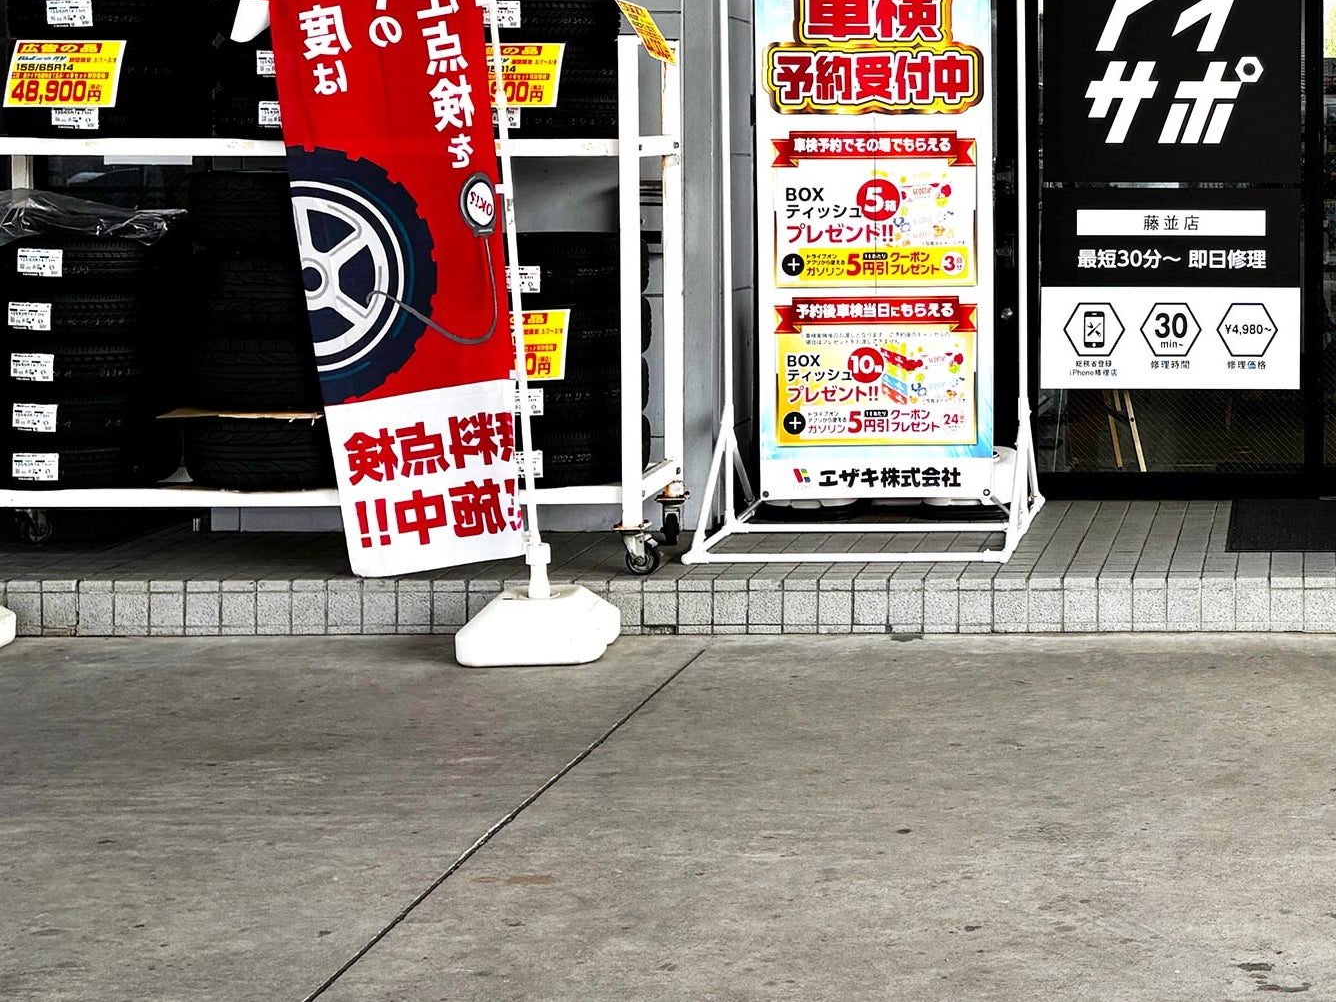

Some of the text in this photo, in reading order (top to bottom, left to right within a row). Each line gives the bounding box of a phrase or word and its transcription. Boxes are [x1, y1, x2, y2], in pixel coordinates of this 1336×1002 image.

[16, 63, 74, 71] 155/65R14
[776, 55, 971, 101] 予約受付中
[794, 137, 951, 153] 車検予約でその場でもらえる
[786, 188, 824, 202] BOX
[786, 204, 862, 219] ティッシュ
[1143, 215, 1200, 231] 藤並店
[1188, 249, 1267, 269] 即日修理
[796, 303, 954, 318] 予約後車検当日にもらえる
[1154, 312, 1188, 339] 30
[787, 354, 821, 367] BOX
[787, 371, 852, 382] ティッシュ
[818, 467, 962, 488] エザキ株式会社
